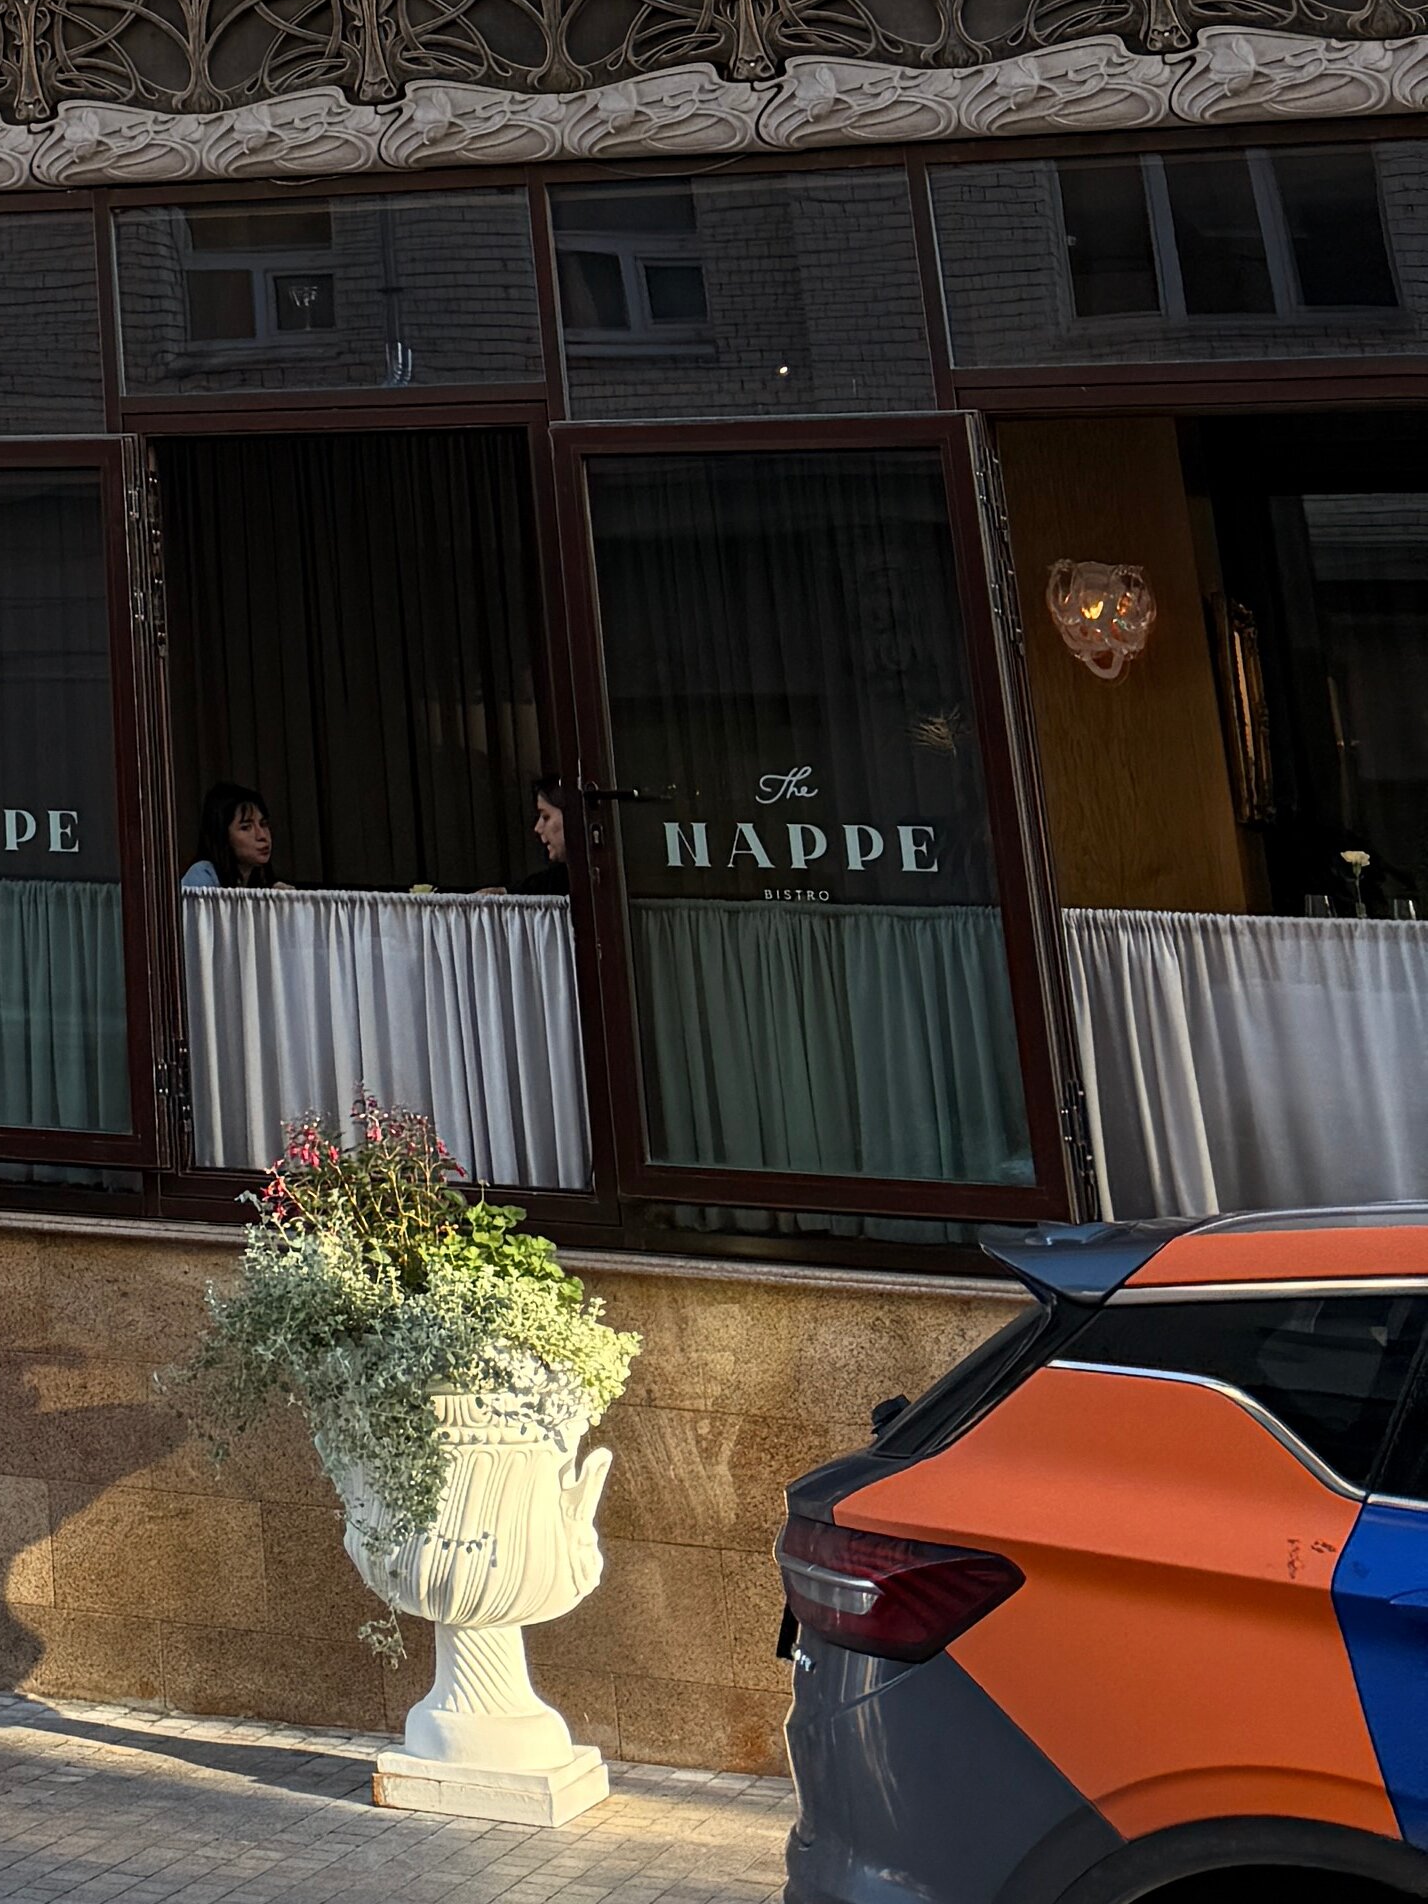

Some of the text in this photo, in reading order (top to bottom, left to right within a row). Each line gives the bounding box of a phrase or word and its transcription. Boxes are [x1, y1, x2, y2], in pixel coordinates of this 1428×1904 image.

[755, 765, 818, 804] The
[663, 822, 939, 872] NAPPE
[764, 889, 830, 902] BISTRO
